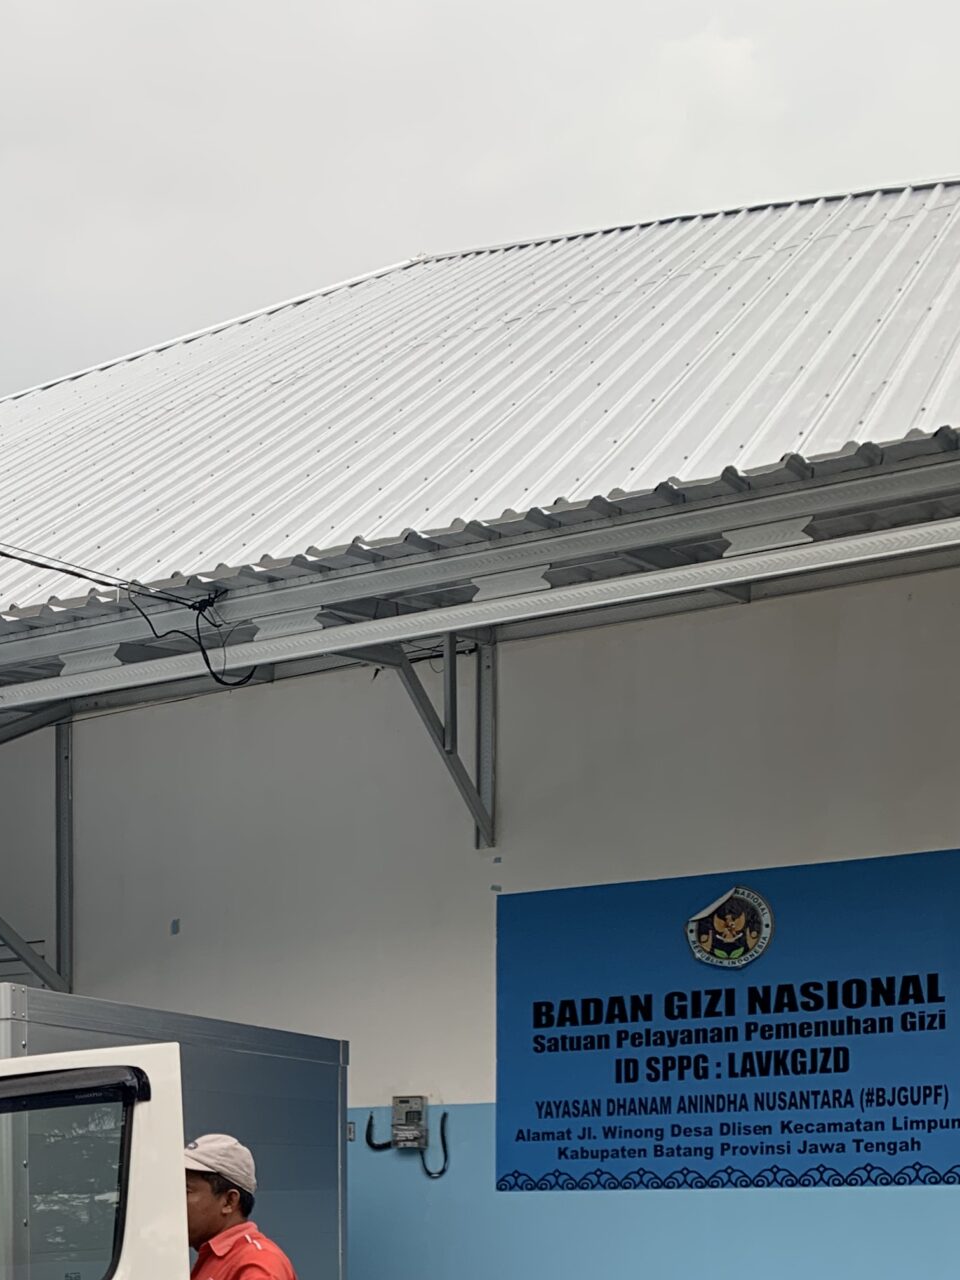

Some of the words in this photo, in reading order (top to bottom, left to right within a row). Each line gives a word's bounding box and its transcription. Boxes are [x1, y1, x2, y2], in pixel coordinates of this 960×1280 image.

[727, 935, 769, 966] INDONESIA
[532, 994, 654, 1029] BADAN
[663, 988, 737, 1021] GIZI
[747, 973, 946, 1015] NASIONAL
[532, 1033, 610, 1054] Satuan
[616, 1025, 739, 1048] Pelayanan
[745, 1015, 894, 1041] Pemenuhan
[900, 1009, 946, 1033] Gizi
[614, 1058, 639, 1084] ID
[645, 1054, 709, 1081] SPPG
[728, 1046, 850, 1078] LAVKGJZD
[535, 1099, 602, 1119] YAYASAN
[606, 1096, 672, 1117] DHANAM
[676, 1092, 749, 1114] ANINDHA
[754, 1088, 855, 1112] NUSANTARA
[860, 1084, 949, 1113] (#BJGUPF)
[515, 1129, 572, 1142] Alamat
[577, 1127, 597, 1141] Jl.
[602, 1125, 665, 1142] Winong
[671, 1123, 713, 1138] Desa
[719, 1121, 772, 1137] Dlisen
[780, 1118, 885, 1136] Kecamatan
[557, 1146, 648, 1162] Kabupaten
[653, 1143, 714, 1160] Batang
[720, 1141, 791, 1157] Provinsi
[797, 1140, 847, 1155] Jawa
[852, 1137, 922, 1156] Tengah
